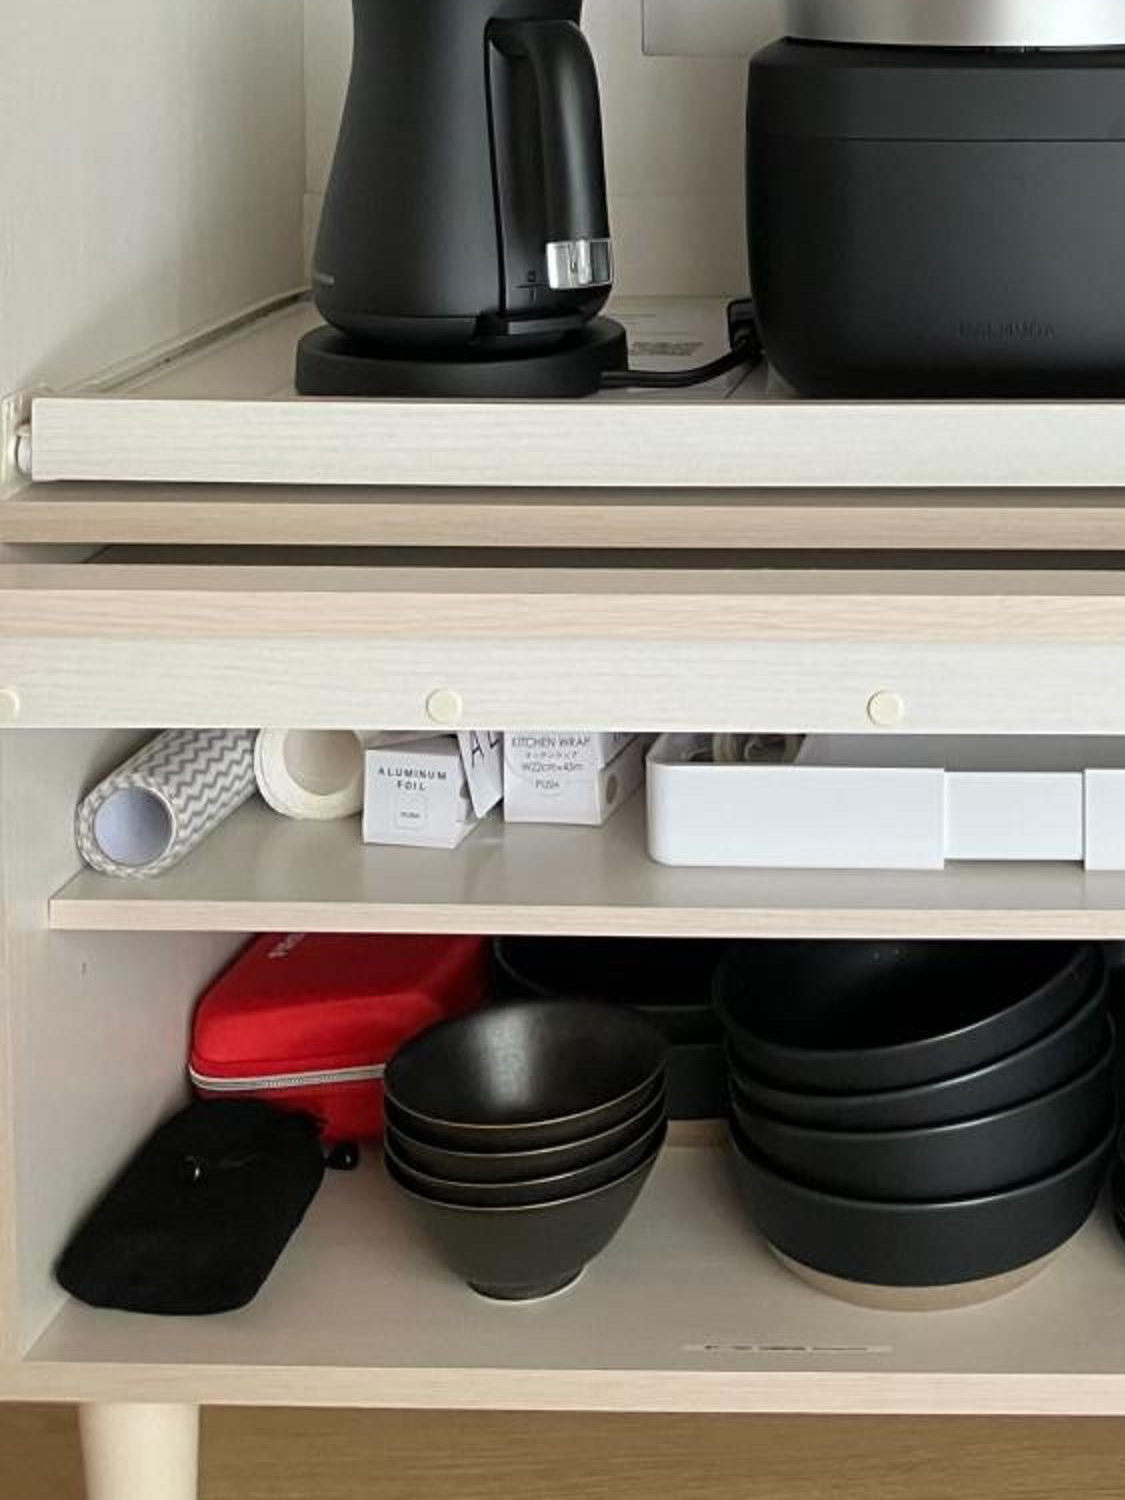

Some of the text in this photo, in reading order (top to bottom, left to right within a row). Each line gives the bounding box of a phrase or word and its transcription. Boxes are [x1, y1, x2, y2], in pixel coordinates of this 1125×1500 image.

[511, 736, 591, 749] KITCHEN WRAP
[378, 766, 447, 780] ALUMINUM
[397, 780, 426, 791] FOIL
